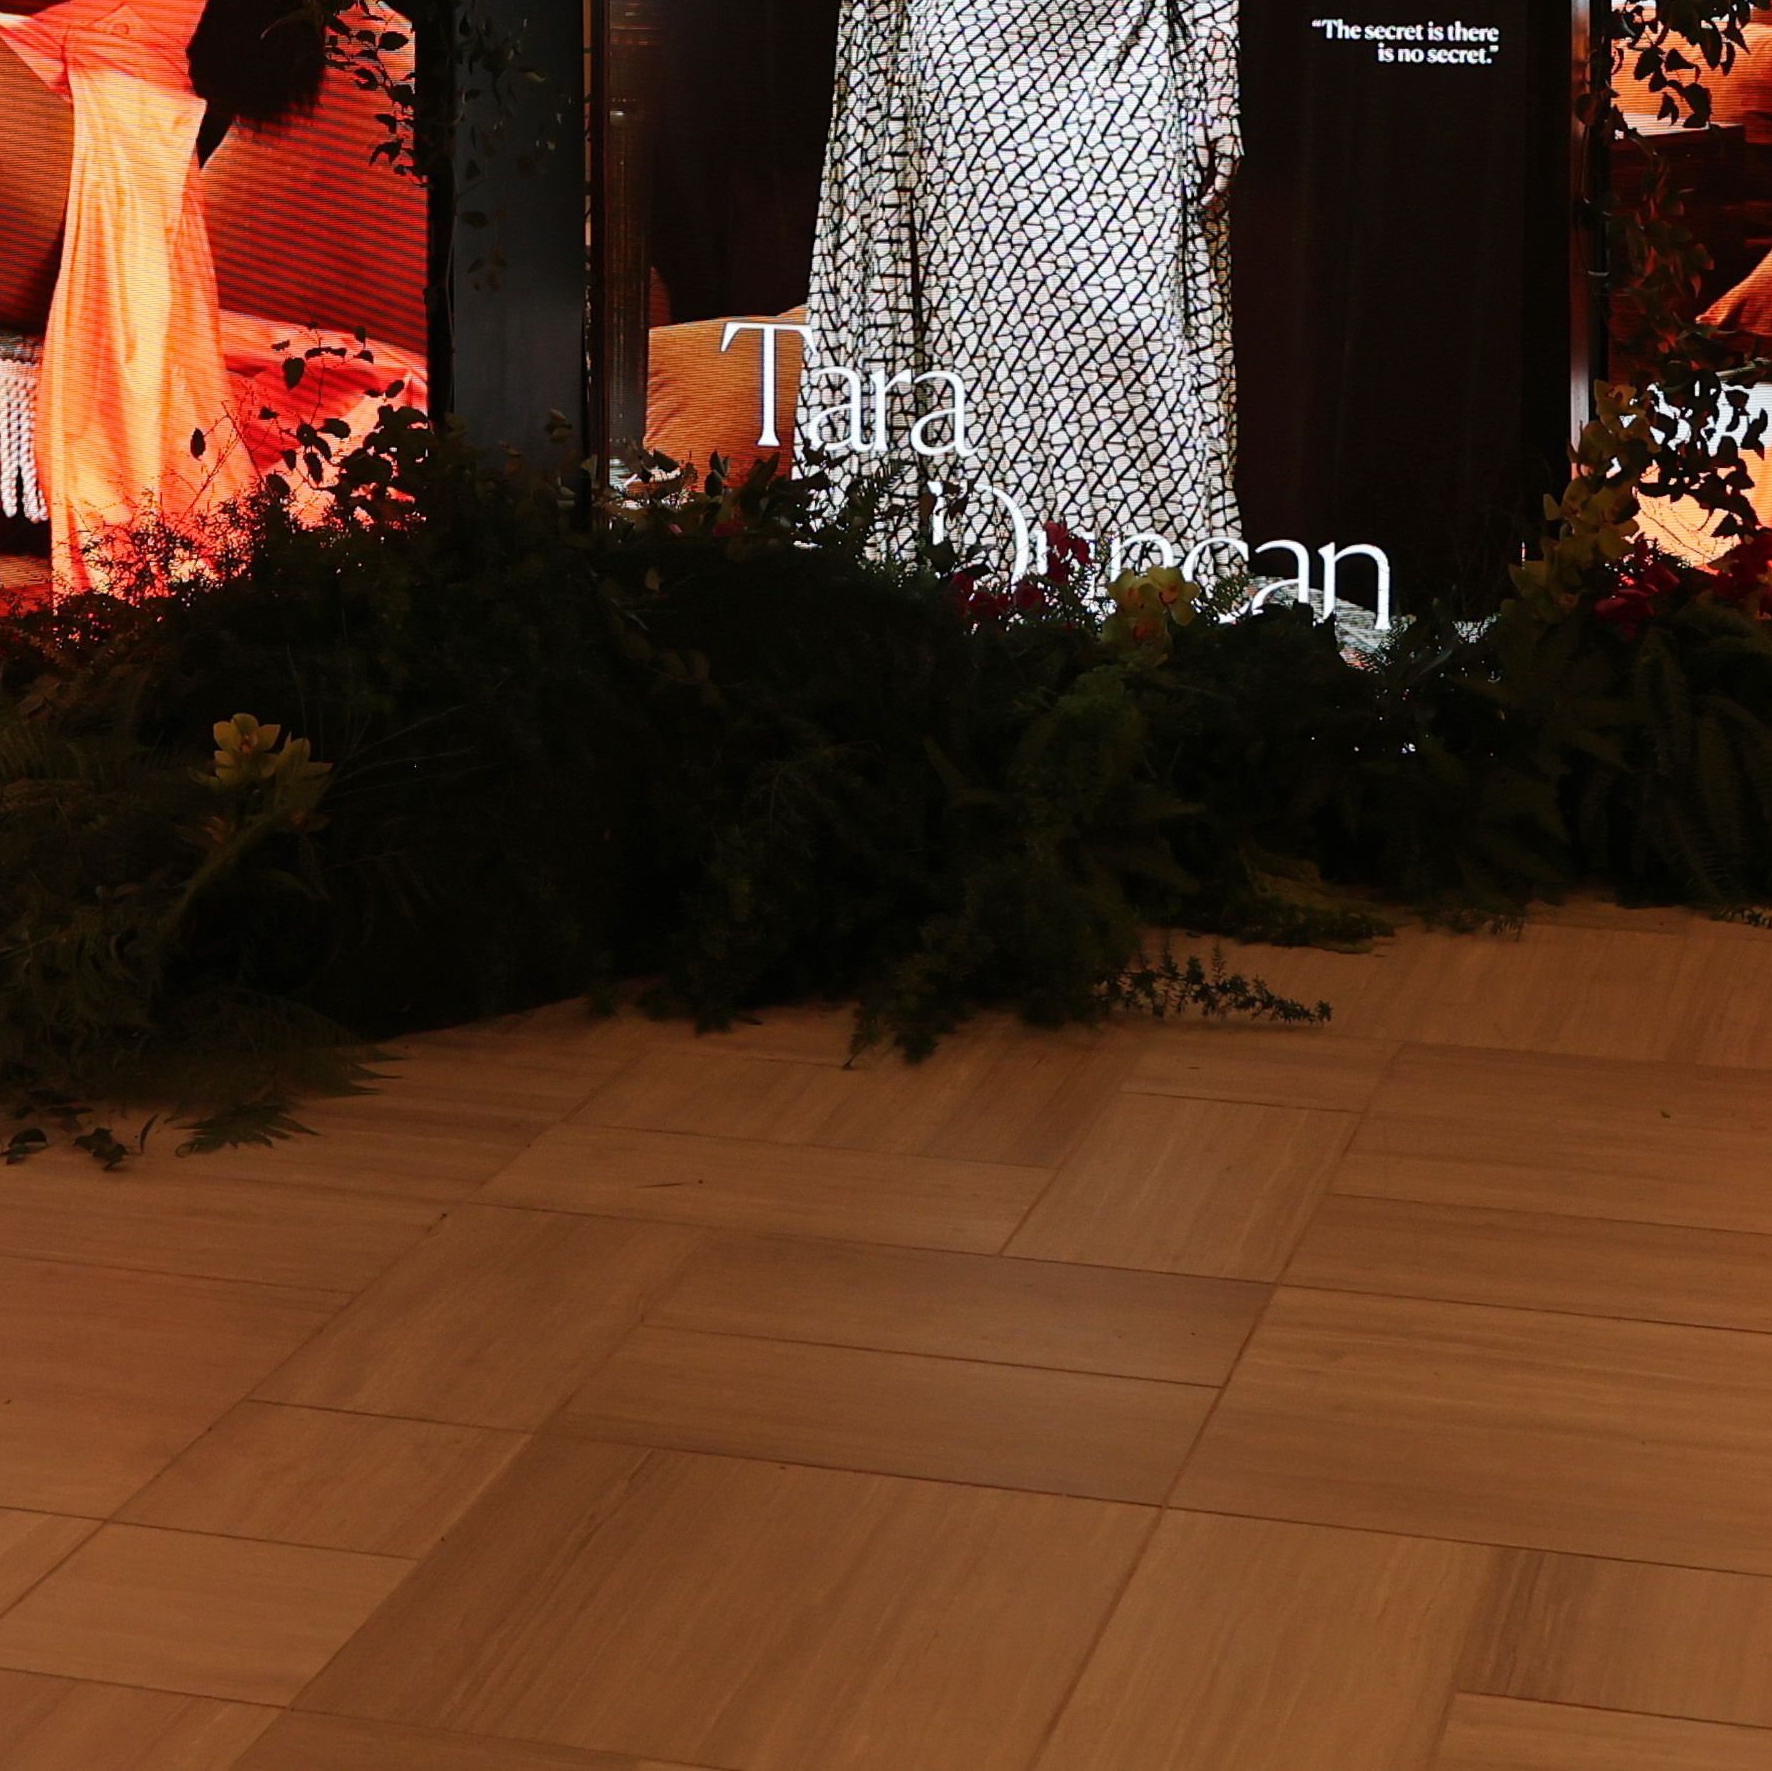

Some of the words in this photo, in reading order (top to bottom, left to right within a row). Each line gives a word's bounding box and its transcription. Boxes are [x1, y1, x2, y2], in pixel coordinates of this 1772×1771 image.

[1311, 18, 1362, 40] “The
[1364, 22, 1424, 41] secret
[1428, 20, 1444, 42] is
[1447, 20, 1500, 43] there
[1378, 42, 1395, 63] is
[1397, 46, 1425, 64] no
[720, 321, 981, 457] Tara
